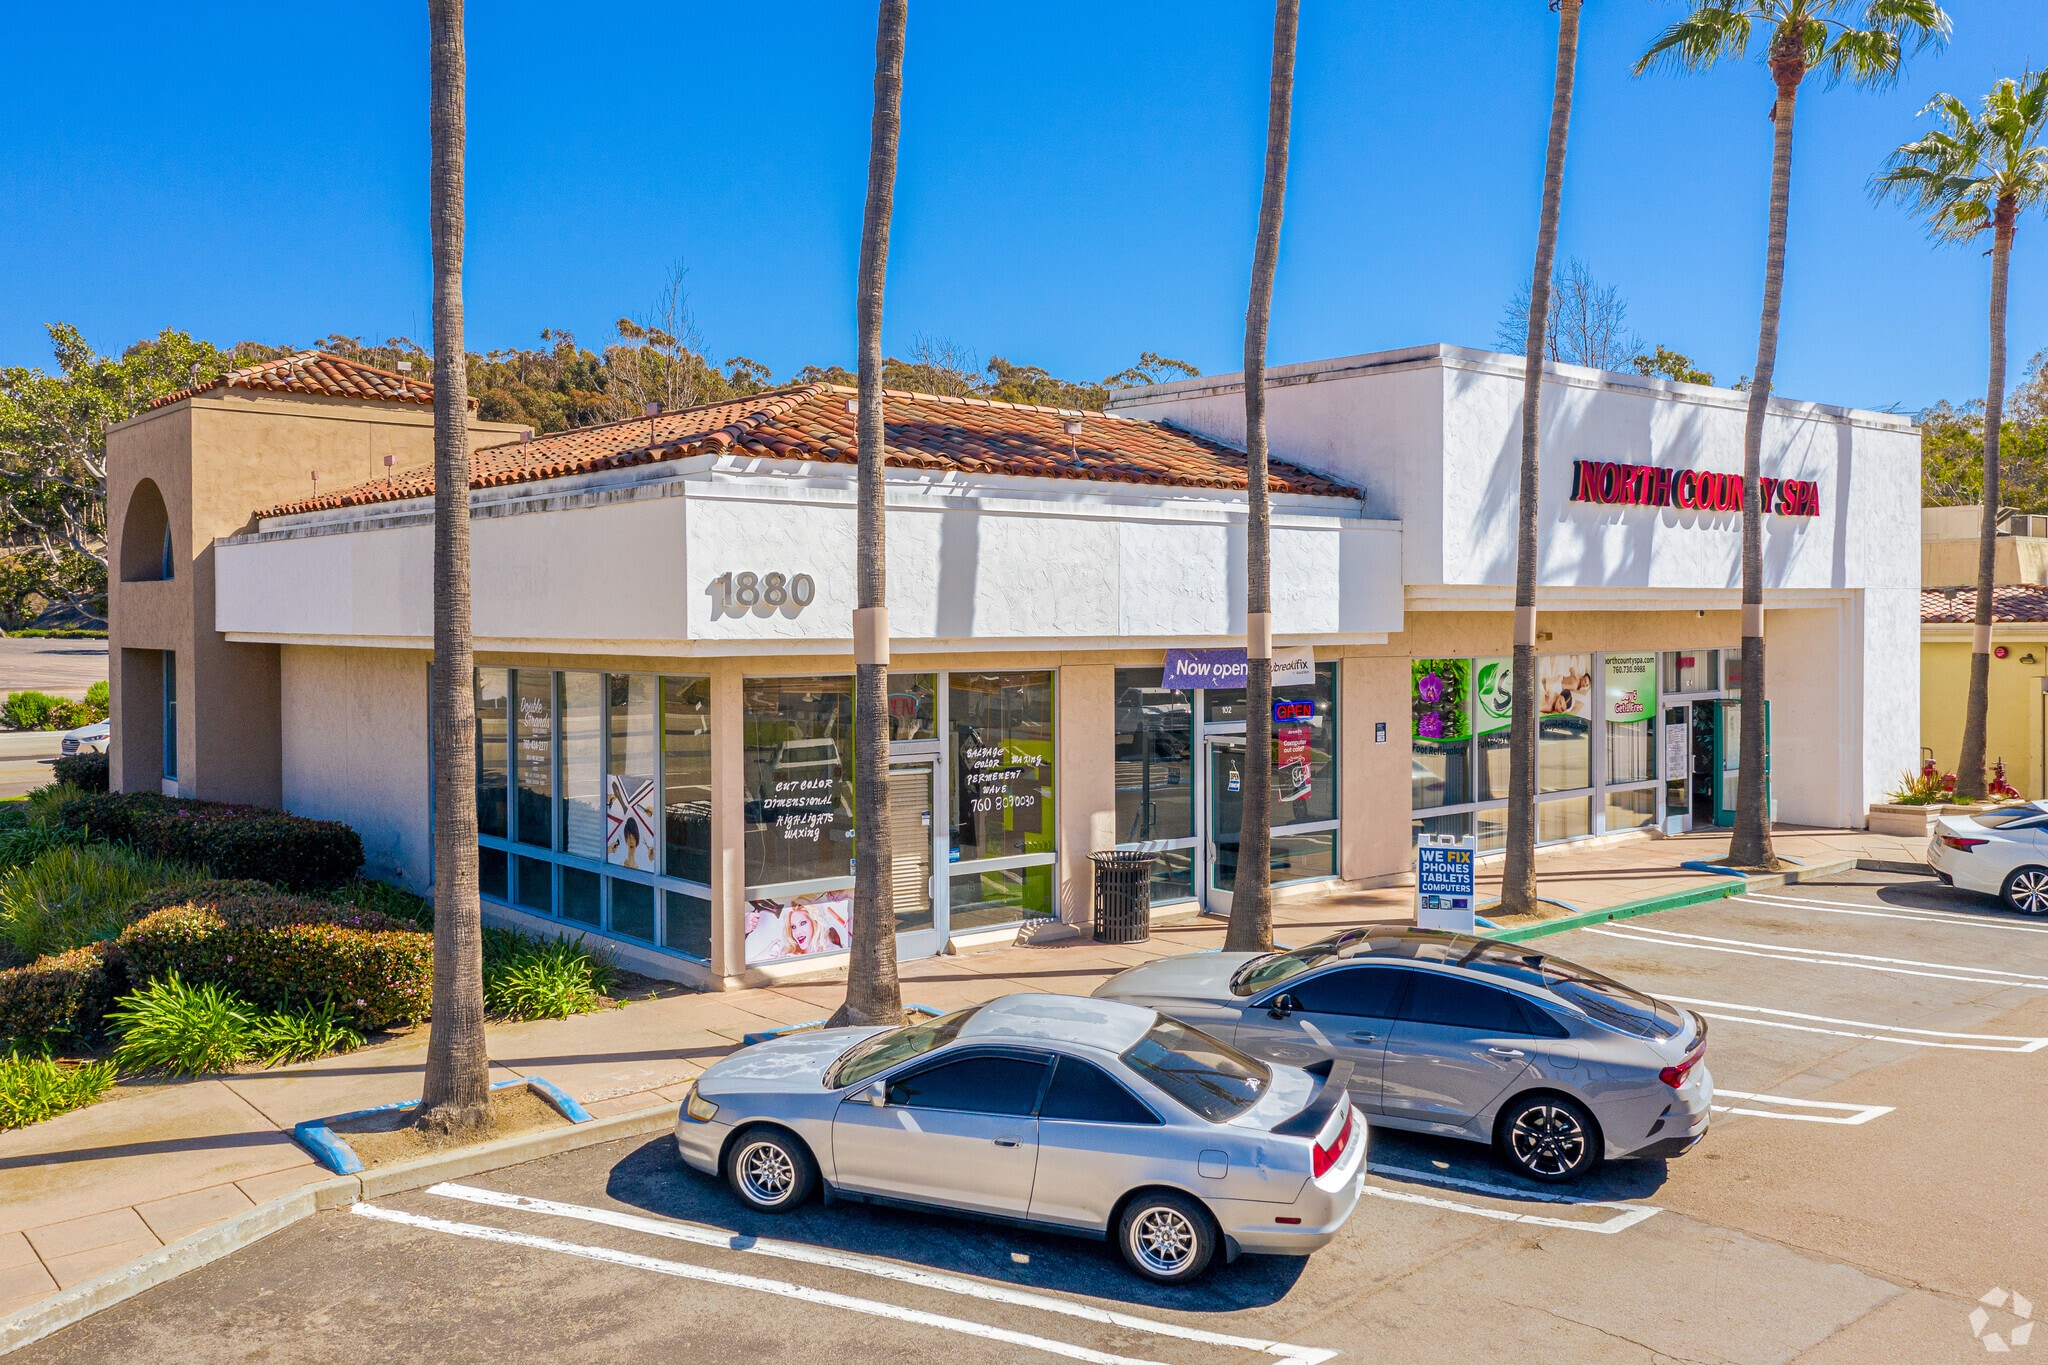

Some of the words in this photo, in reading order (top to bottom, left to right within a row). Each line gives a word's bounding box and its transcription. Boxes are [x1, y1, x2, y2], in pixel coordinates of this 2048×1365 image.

[1570, 460, 1673, 507] NORTH
[1672, 469, 1778, 513] COUNY
[1776, 478, 1820, 517] SPA
[715, 571, 816, 607] 1880
[1176, 659, 1211, 676] Now
[1212, 662, 1248, 680] open
[1221, 706, 1232, 714] 102
[1277, 704, 1311, 719] OPEN
[1283, 740, 1307, 752] Computer
[1412, 743, 1427, 754] Foot
[974, 758, 1000, 769] COLOR
[966, 769, 1022, 785] PERMENENT
[775, 781, 800, 792] CUT
[800, 778, 834, 790] COLOR
[982, 784, 1007, 795] WAVE
[970, 797, 992, 812] 760
[1421, 850, 1444, 862] WE
[1447, 851, 1471, 863] FIX
[1422, 862, 1469, 873] PHONES
[1421, 872, 1470, 883] TABLETS
[1422, 883, 1471, 893] COMPUTERS
